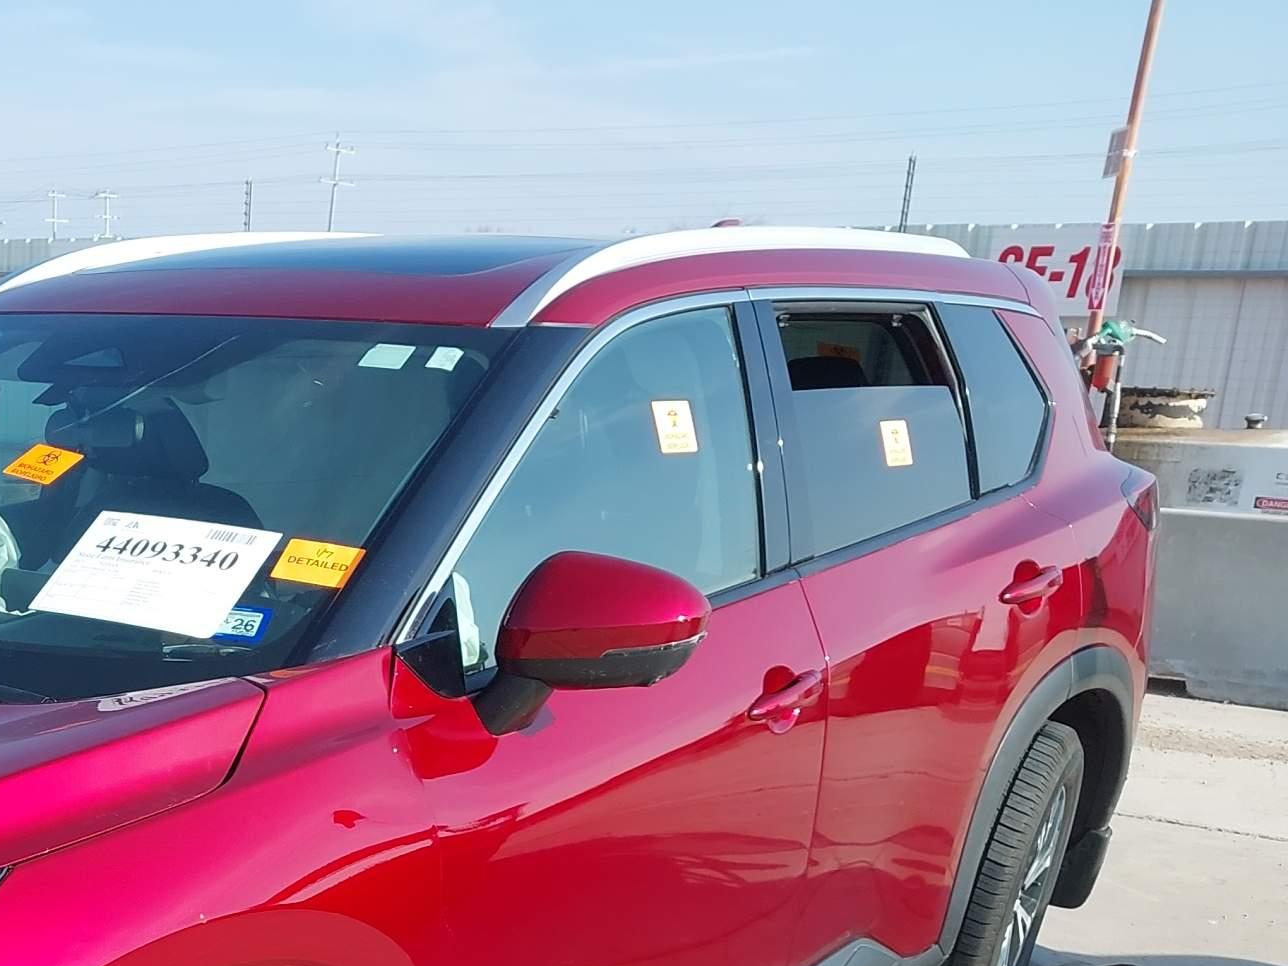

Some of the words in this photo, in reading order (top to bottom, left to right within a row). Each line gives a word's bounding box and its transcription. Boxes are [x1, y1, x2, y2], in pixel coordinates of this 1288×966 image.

[96, 535, 239, 571] 44093340
[287, 556, 349, 572] DETAILED
[232, 618, 256, 632] 26
